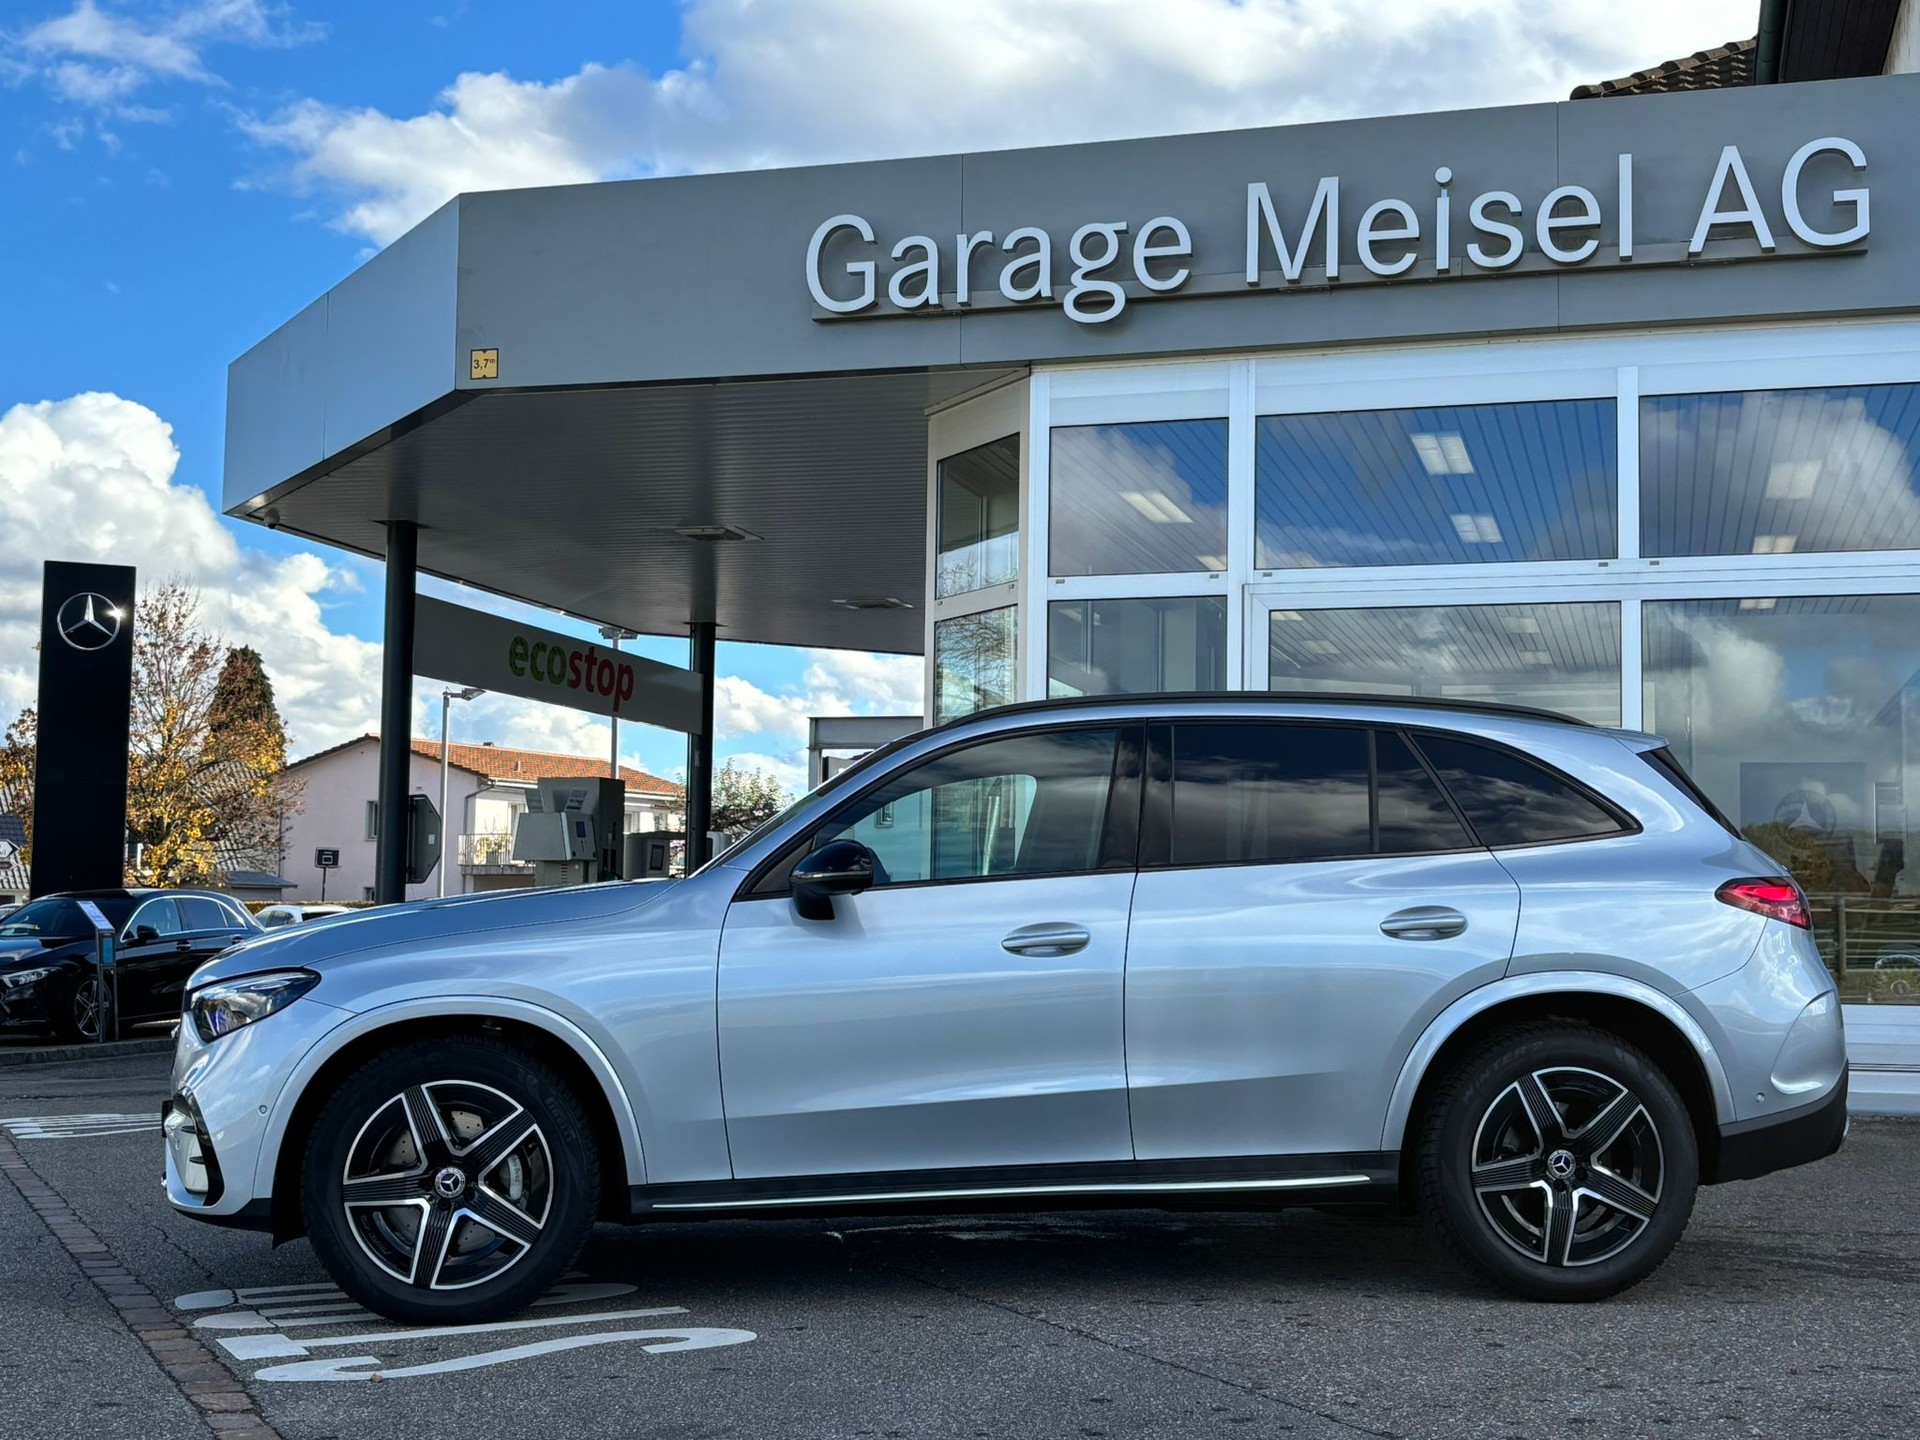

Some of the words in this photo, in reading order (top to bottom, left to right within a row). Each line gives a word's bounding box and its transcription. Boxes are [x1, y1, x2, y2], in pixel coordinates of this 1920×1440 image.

[806, 214, 1192, 323] Garage
[1246, 153, 1633, 285] Meisel
[1688, 137, 1870, 253] AG
[509, 636, 634, 713] ecostop
